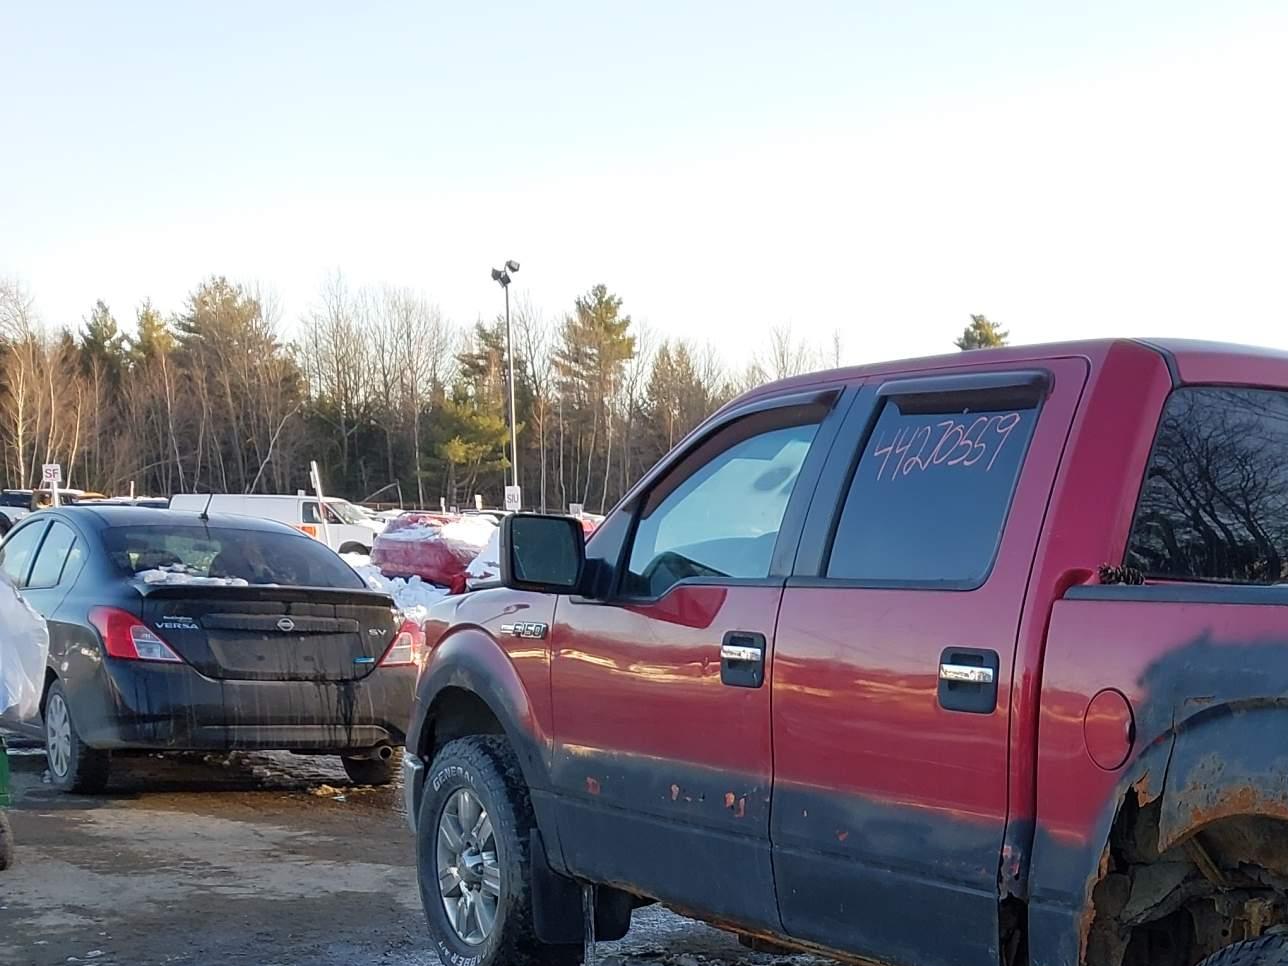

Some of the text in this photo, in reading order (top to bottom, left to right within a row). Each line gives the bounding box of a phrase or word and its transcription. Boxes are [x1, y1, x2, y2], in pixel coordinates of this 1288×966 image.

[874, 412, 1021, 481] 44270559
[44, 468, 59, 479] SF
[155, 622, 199, 630] VERSA
[368, 628, 387, 636] SV
